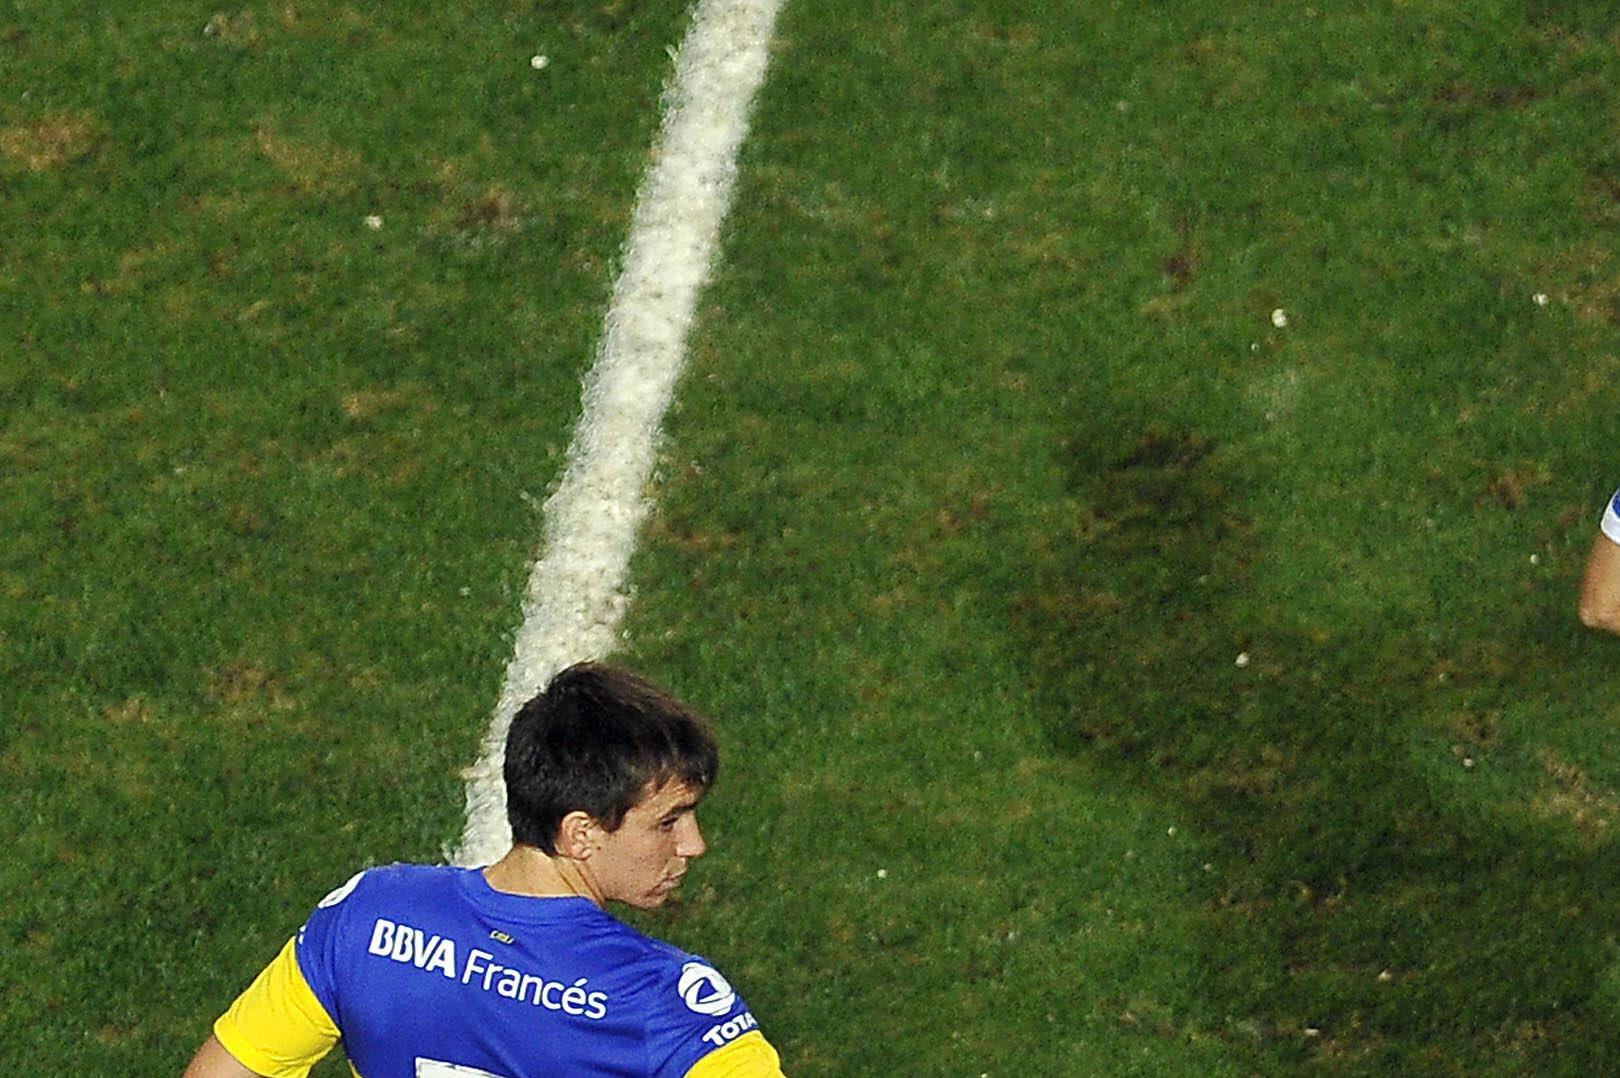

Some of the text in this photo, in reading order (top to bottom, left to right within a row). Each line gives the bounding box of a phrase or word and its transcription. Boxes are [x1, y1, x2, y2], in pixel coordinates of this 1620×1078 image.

[368, 918, 609, 1019] BBVA Francés
[702, 1011, 758, 1046] TOTA
